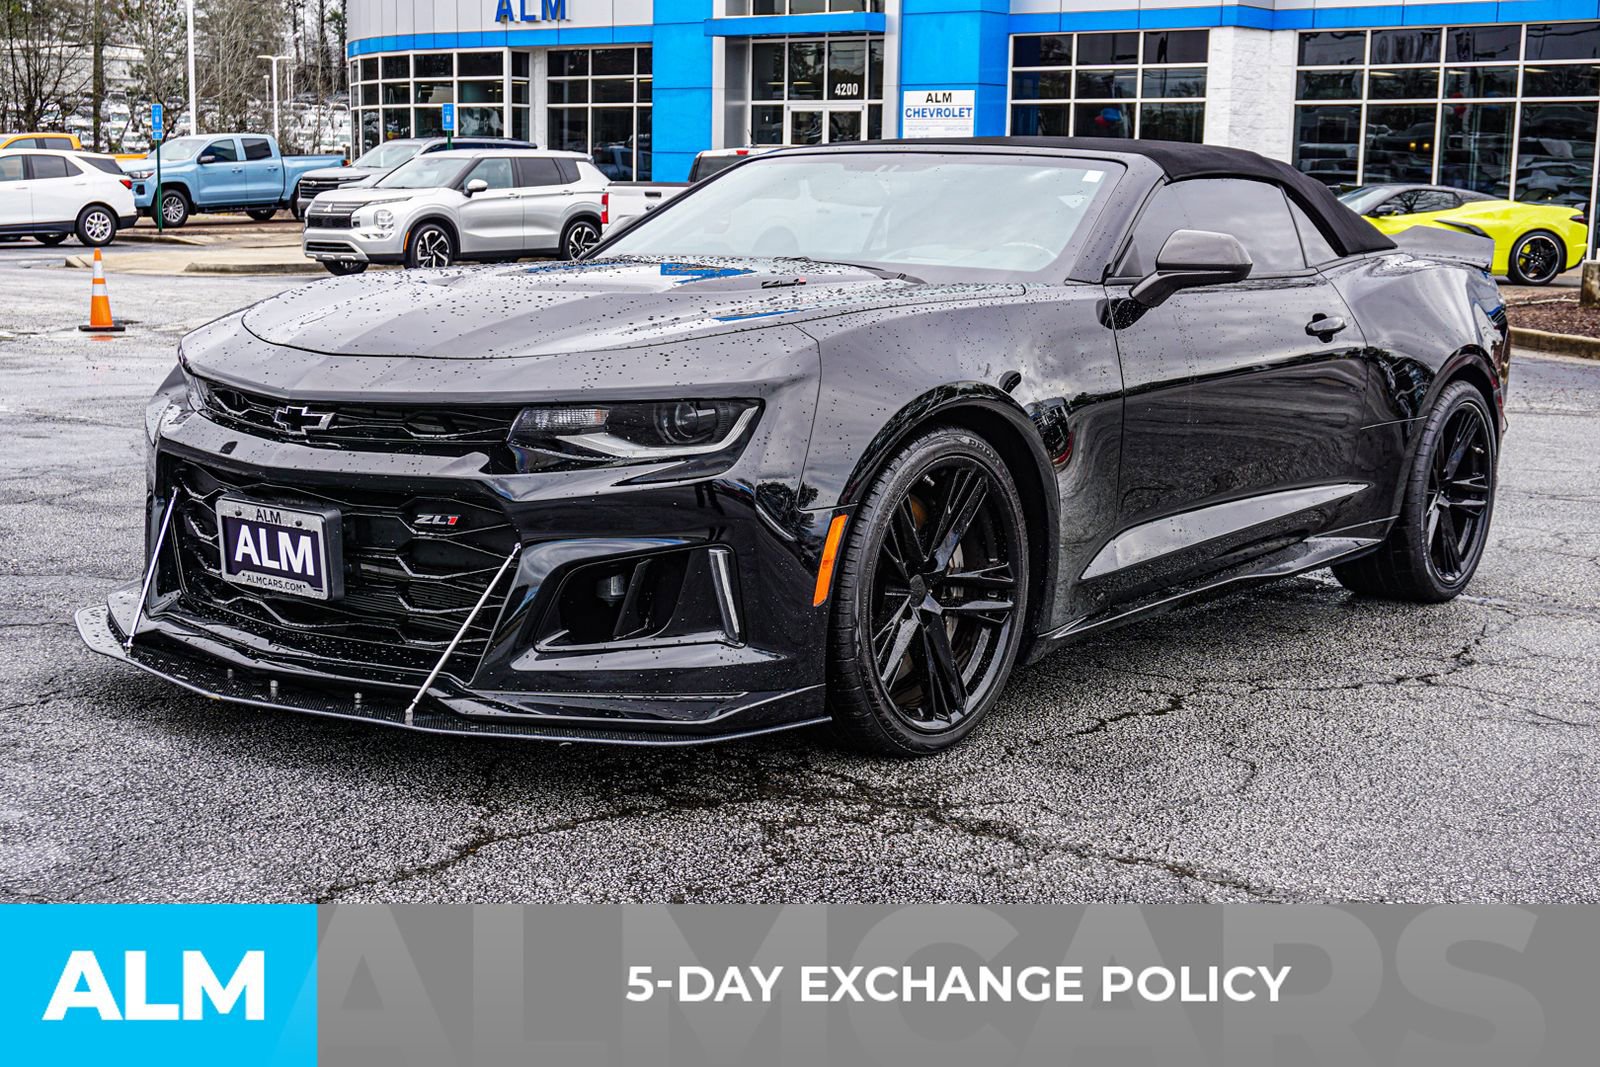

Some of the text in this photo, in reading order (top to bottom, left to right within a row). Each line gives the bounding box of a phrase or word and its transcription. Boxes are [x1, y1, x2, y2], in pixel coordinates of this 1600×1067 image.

[495, 0, 566, 22] ALM
[834, 83, 859, 96] 4200
[925, 92, 953, 103] ALM
[905, 107, 973, 118] CHEVROLET
[255, 508, 282, 525] ALM
[414, 514, 459, 525] ZL1
[234, 524, 315, 577] ALM
